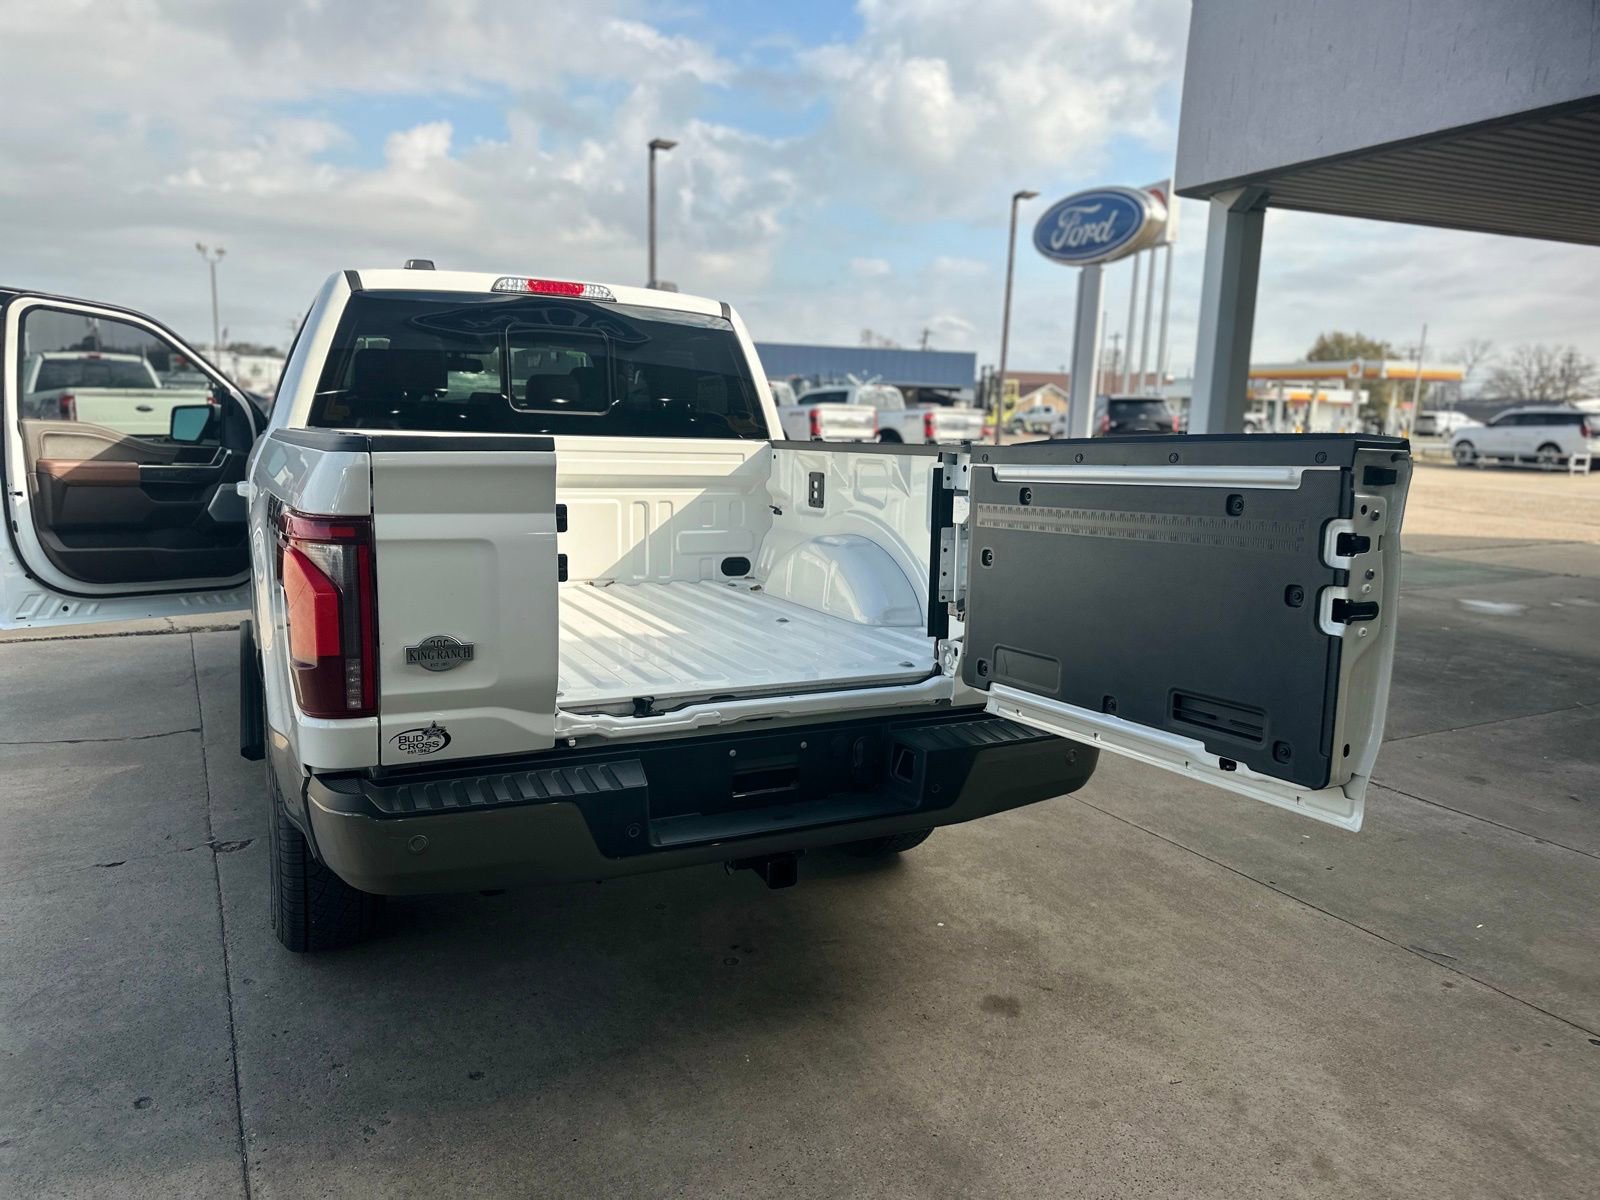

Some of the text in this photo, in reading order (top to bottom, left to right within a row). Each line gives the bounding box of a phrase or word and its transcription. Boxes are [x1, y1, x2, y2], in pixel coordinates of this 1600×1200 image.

[1051, 203, 1119, 251] Ford
[409, 647, 471, 662] KING RANCH
[398, 735, 424, 744] BUD
[398, 741, 440, 751] CROSS
